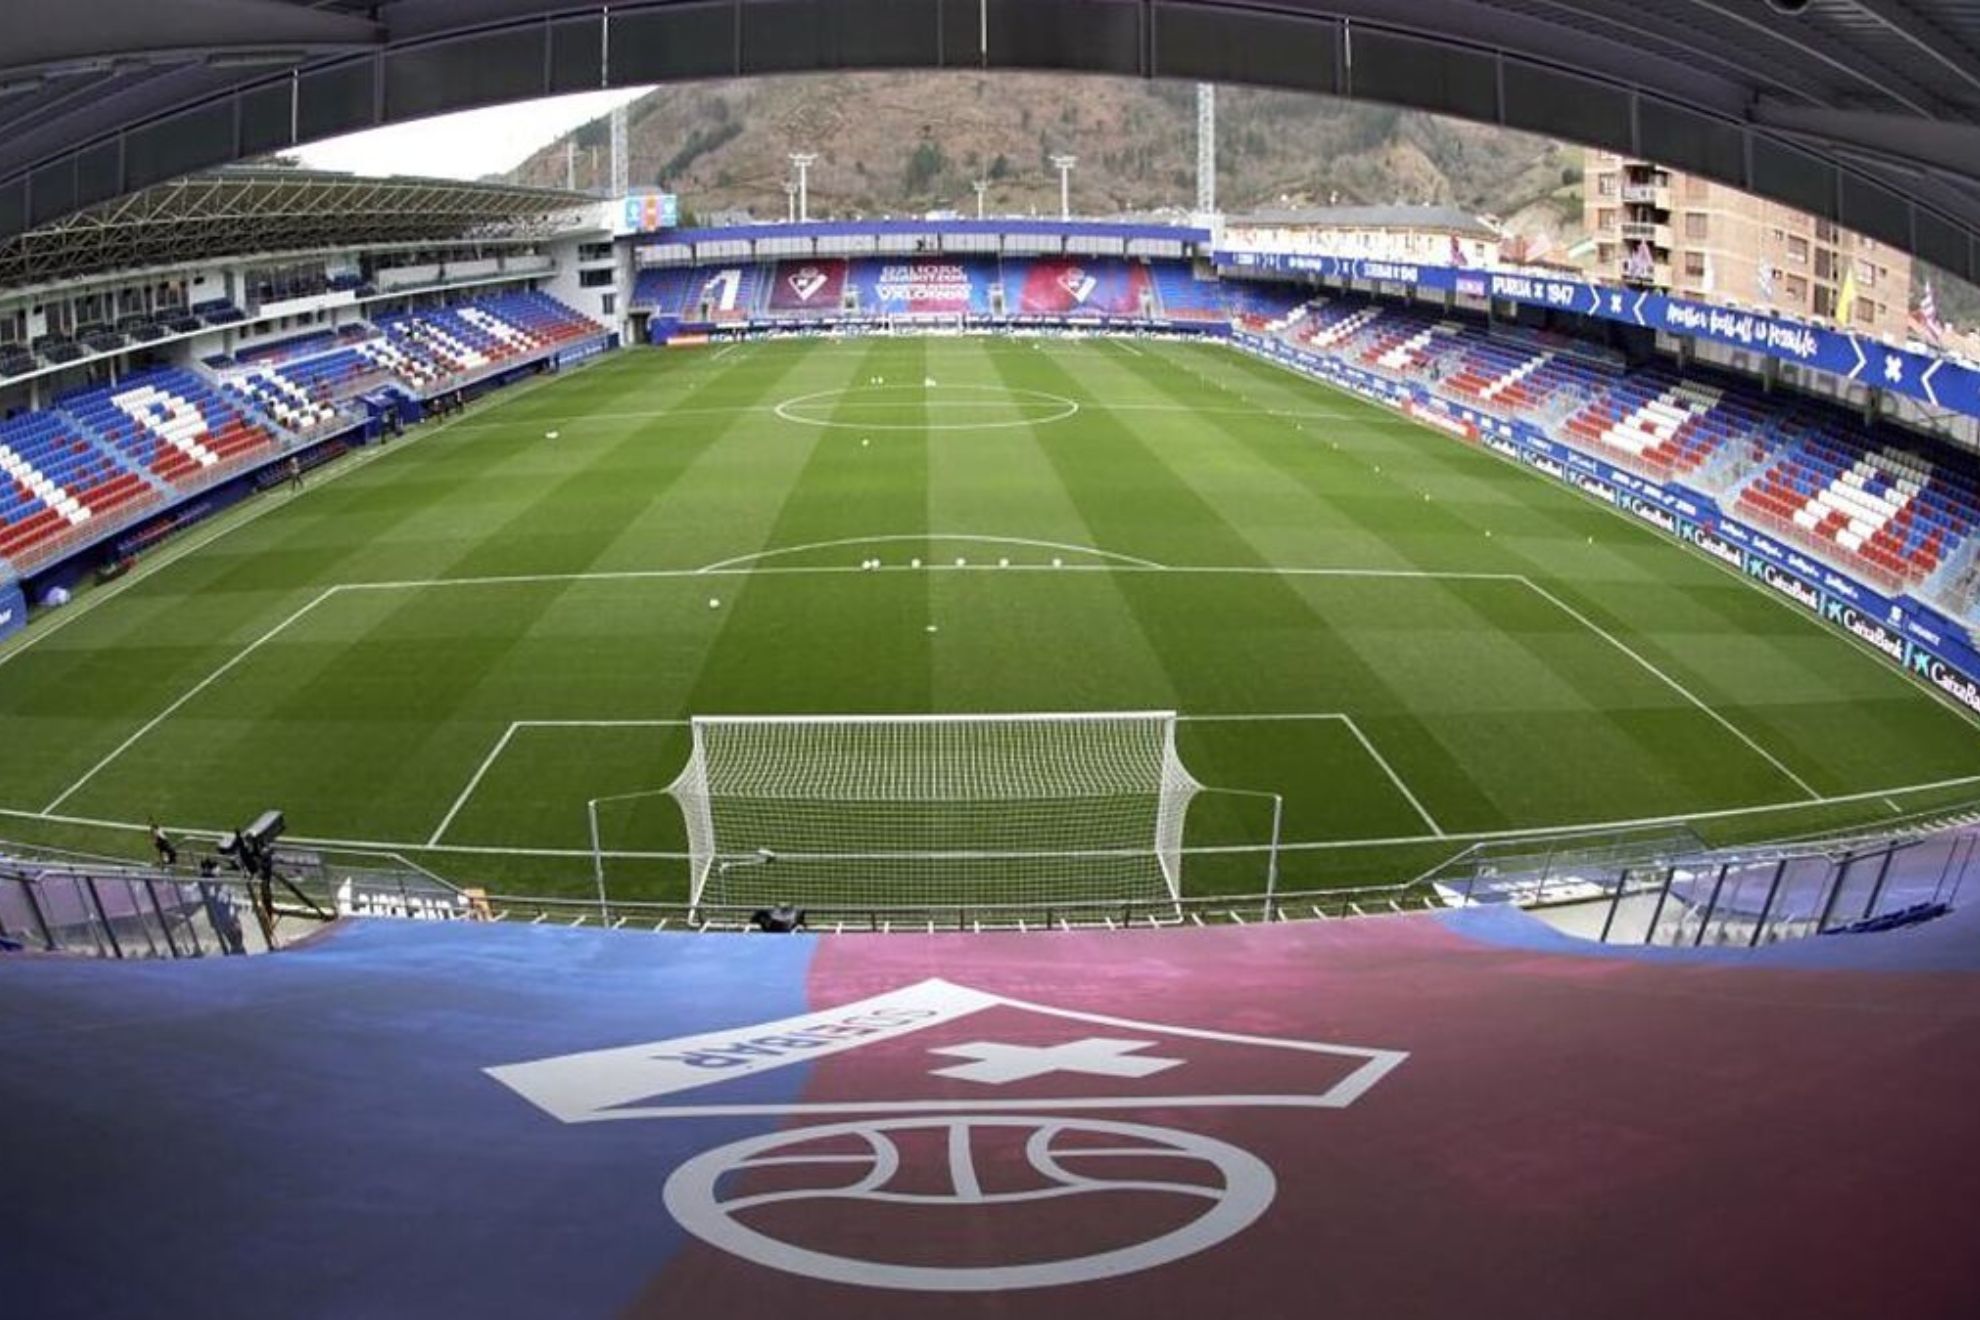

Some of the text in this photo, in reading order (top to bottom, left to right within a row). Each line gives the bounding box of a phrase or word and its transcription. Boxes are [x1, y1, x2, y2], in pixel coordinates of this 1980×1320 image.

[1694, 529, 1742, 568] CaixaBank
[1764, 565, 1817, 611] CaixaBank
[1843, 609, 1903, 661] CaixaBank
